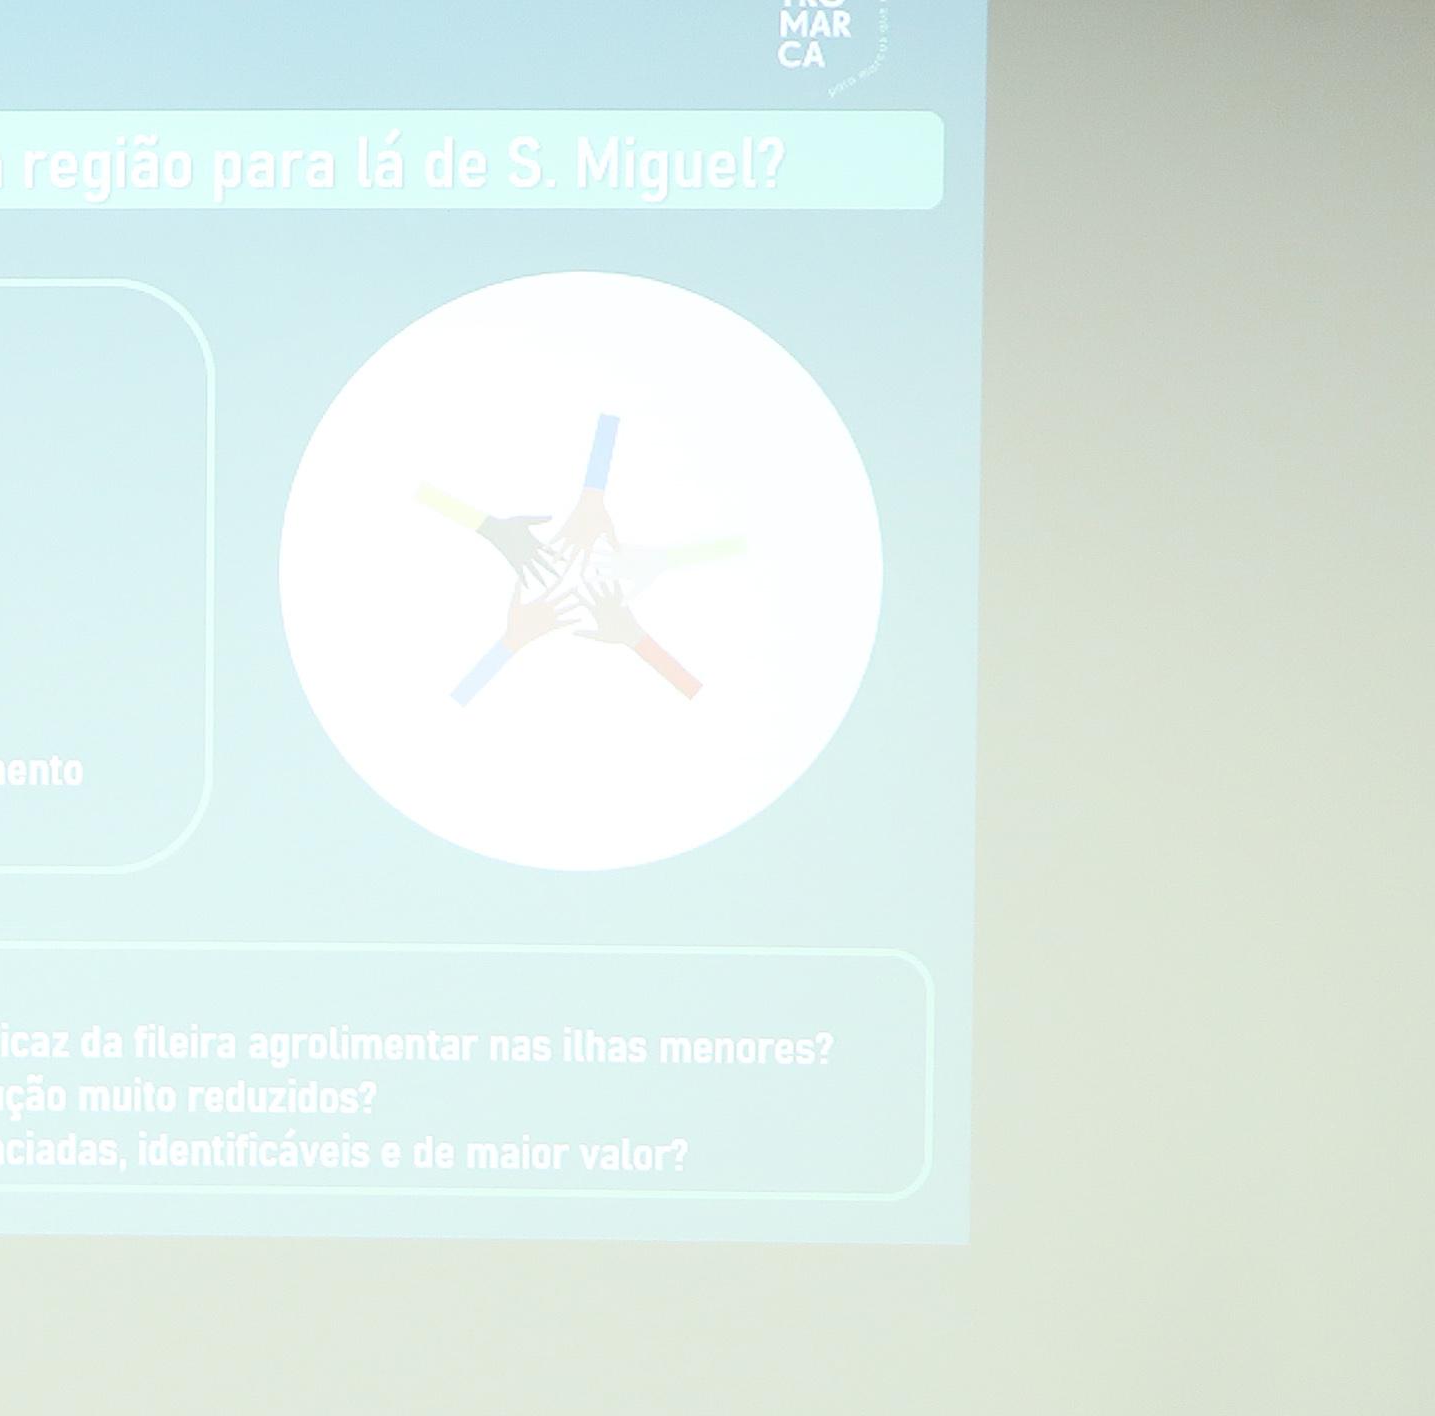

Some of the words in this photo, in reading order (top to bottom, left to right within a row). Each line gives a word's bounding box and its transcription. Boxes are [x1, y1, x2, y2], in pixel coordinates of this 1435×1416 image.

[780, 10, 851, 38] MAR
[777, 40, 825, 68] CA
[25, 135, 190, 201] região
[215, 151, 333, 202] para
[359, 129, 402, 187] lá
[426, 138, 485, 187] de
[509, 137, 555, 187] S.
[578, 137, 783, 202] Miguel?
[81, 1025, 122, 1057] da
[134, 1024, 235, 1058] fileira
[249, 1025, 478, 1069] agrolimentar
[490, 1036, 551, 1062] nas
[564, 1027, 647, 1063] ilhas
[660, 1032, 833, 1064] menores?
[79, 1077, 176, 1112] muito
[188, 1078, 376, 1114] reduzidos?
[139, 1130, 370, 1168] identificáveis
[381, 1142, 401, 1168] e
[414, 1136, 454, 1168] de
[467, 1135, 570, 1169] maior
[579, 1138, 688, 1171] valor?
